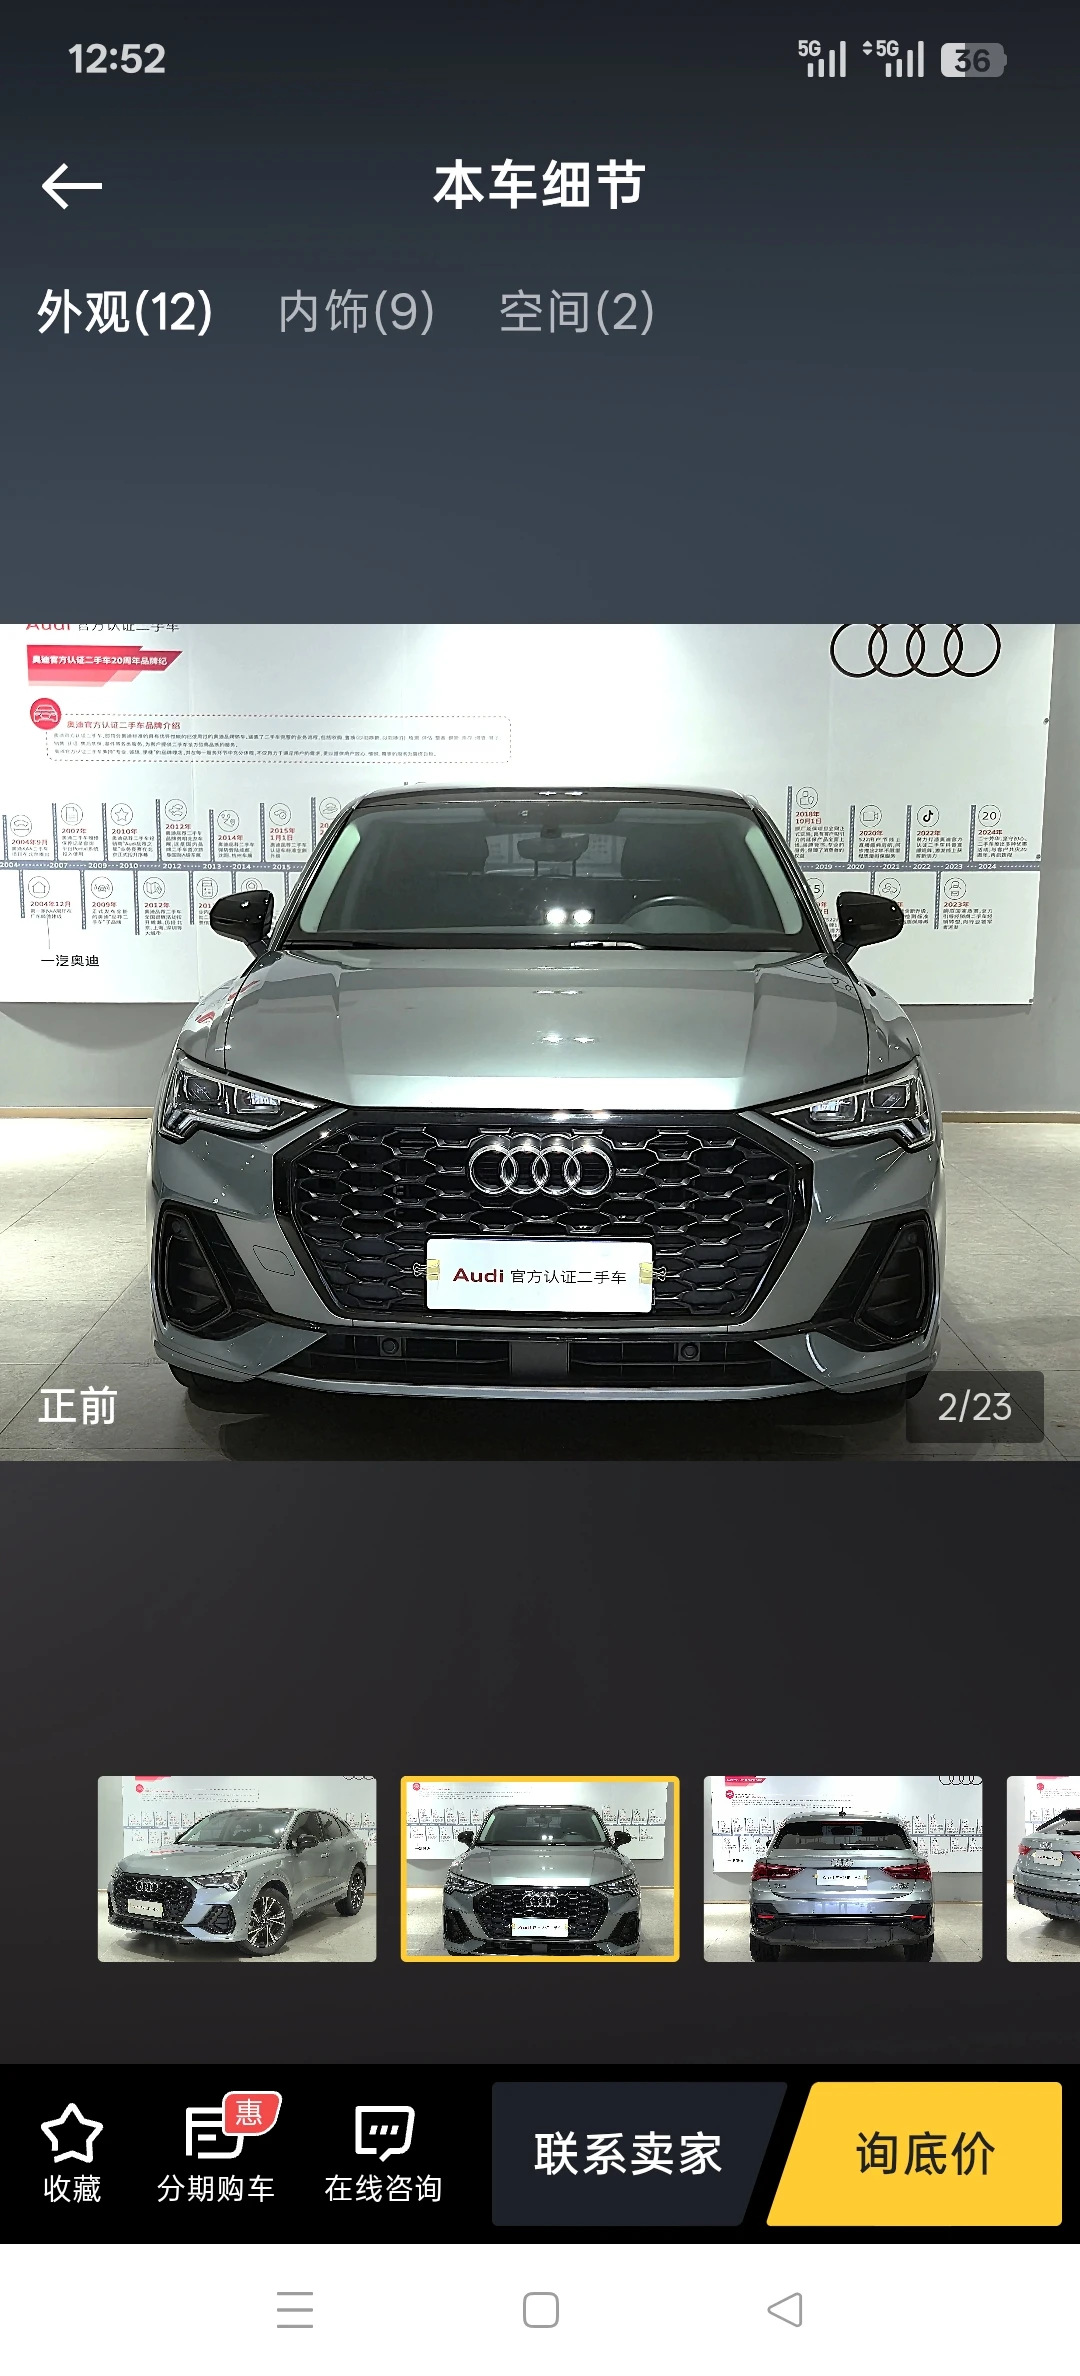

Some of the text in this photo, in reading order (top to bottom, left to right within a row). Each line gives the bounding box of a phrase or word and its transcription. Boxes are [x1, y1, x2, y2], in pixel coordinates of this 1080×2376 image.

[68, 43, 166, 74] 12:52
[798, 40, 821, 57] 5G
[876, 40, 899, 57] 5G
[954, 49, 991, 73] 36
[433, 158, 645, 209] 本车细节
[37, 288, 212, 336] 外观(12)
[280, 288, 434, 336] 内饰(9)
[499, 288, 654, 336] 空间(2)
[981, 810, 997, 821] 20
[41, 954, 100, 967] 一汽奥迪
[453, 1268, 627, 1284] Audi 官方认证二手车
[235, 2097, 263, 2128] 惠
[534, 2130, 723, 2176] 联系卖家
[856, 2130, 996, 2176] 询底价
[43, 2173, 102, 2204] 收藏
[157, 2173, 275, 2203] 分期购车
[324, 2173, 442, 2203] 在线咨询
